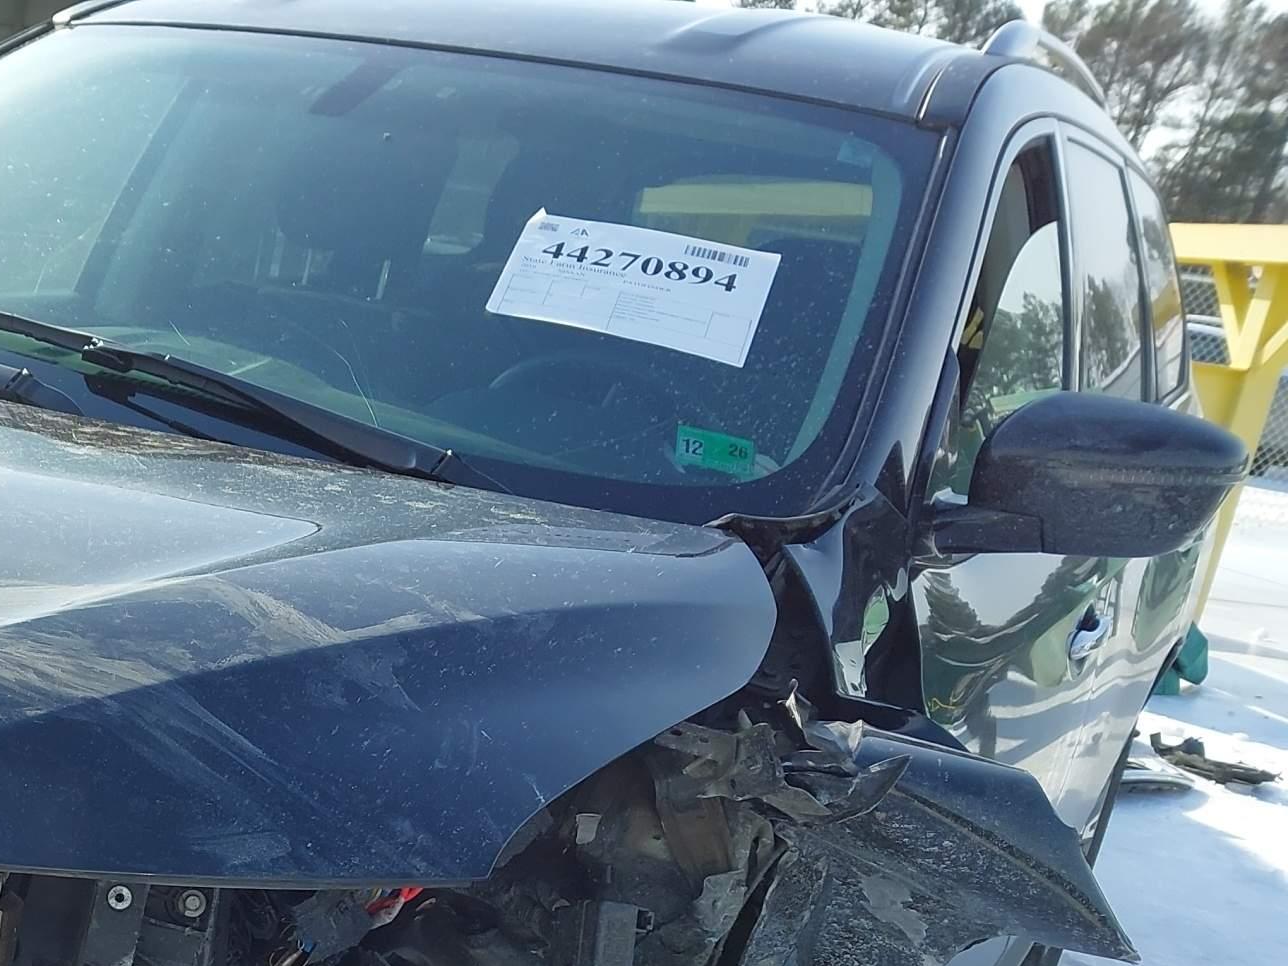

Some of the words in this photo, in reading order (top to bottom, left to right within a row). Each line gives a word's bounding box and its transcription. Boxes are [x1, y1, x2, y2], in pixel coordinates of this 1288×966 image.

[541, 241, 737, 292] 44270894
[682, 438, 704, 456] 12
[728, 443, 748, 460] 26
